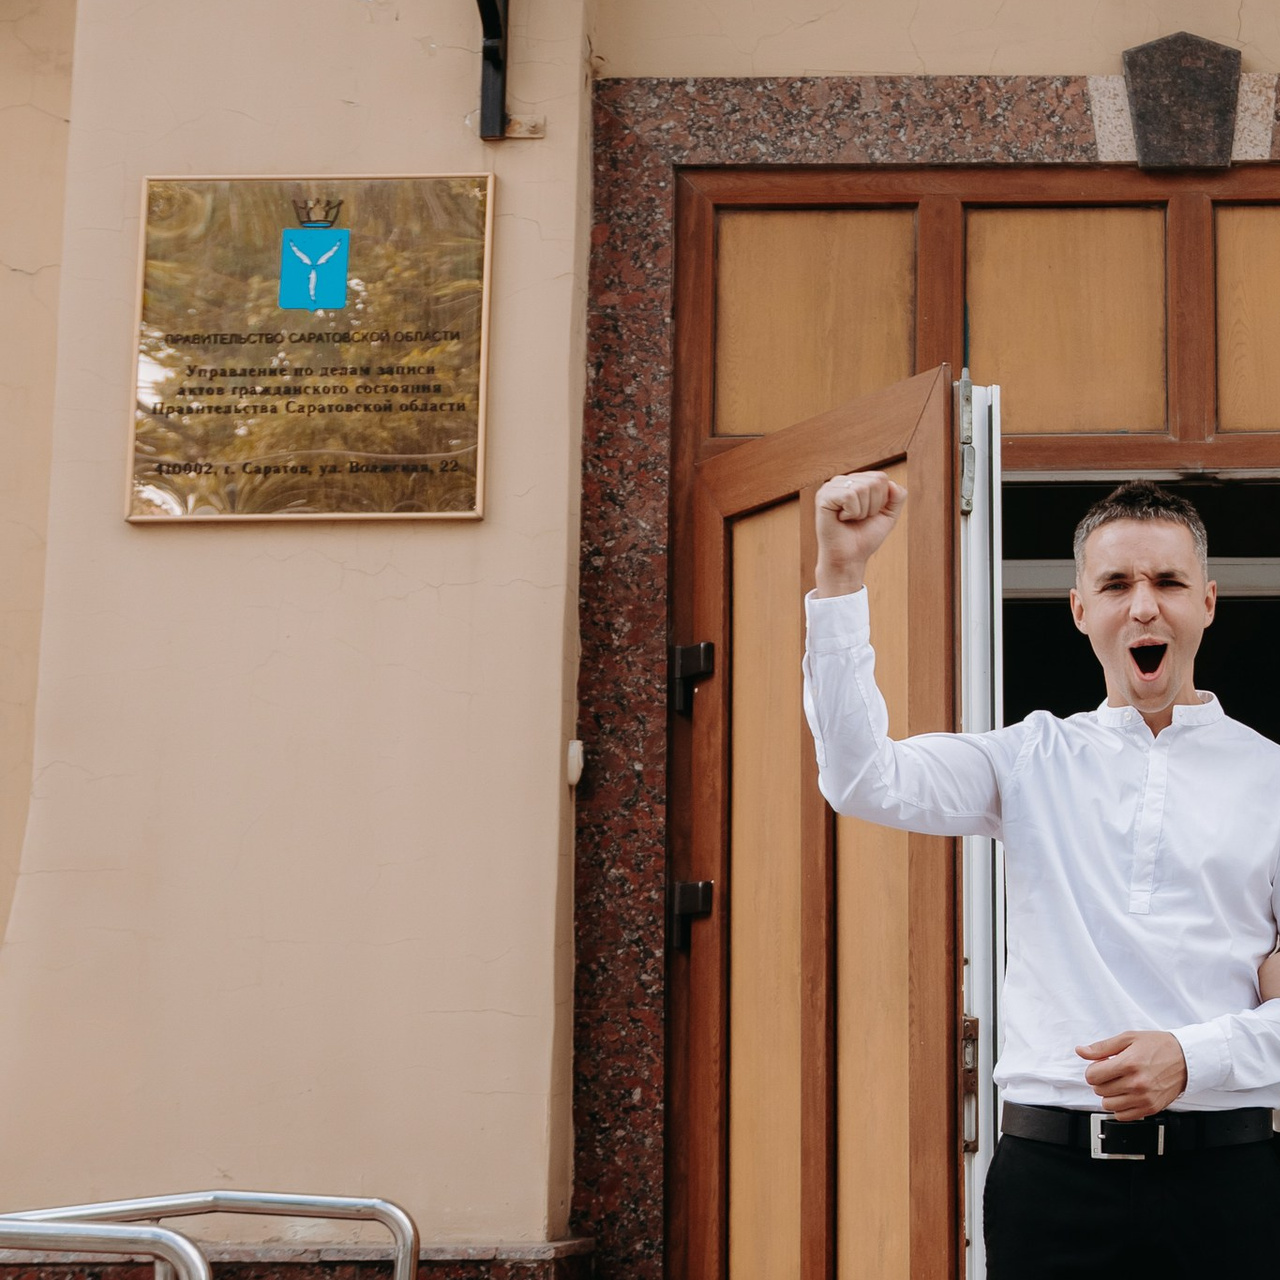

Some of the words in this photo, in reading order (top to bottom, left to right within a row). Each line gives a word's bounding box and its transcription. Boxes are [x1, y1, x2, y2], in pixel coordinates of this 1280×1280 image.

[165, 333, 284, 344] ПРАВИТЕЛЬСТВО
[290, 331, 389, 343] САРАТОВСКОЙ
[394, 331, 460, 341] ОБЛАСТИ
[186, 365, 287, 380] Управление
[294, 366, 313, 376] по
[320, 366, 370, 376] делам
[377, 365, 434, 375] записи
[177, 386, 224, 395] актов
[232, 385, 348, 397] гражданского
[356, 384, 441, 394] состояния
[152, 403, 277, 417] Правительства
[286, 400, 392, 416] Саратовской
[400, 400, 465, 411] области
[243, 463, 312, 476] Саратов,
[440, 460, 458, 471] 22
